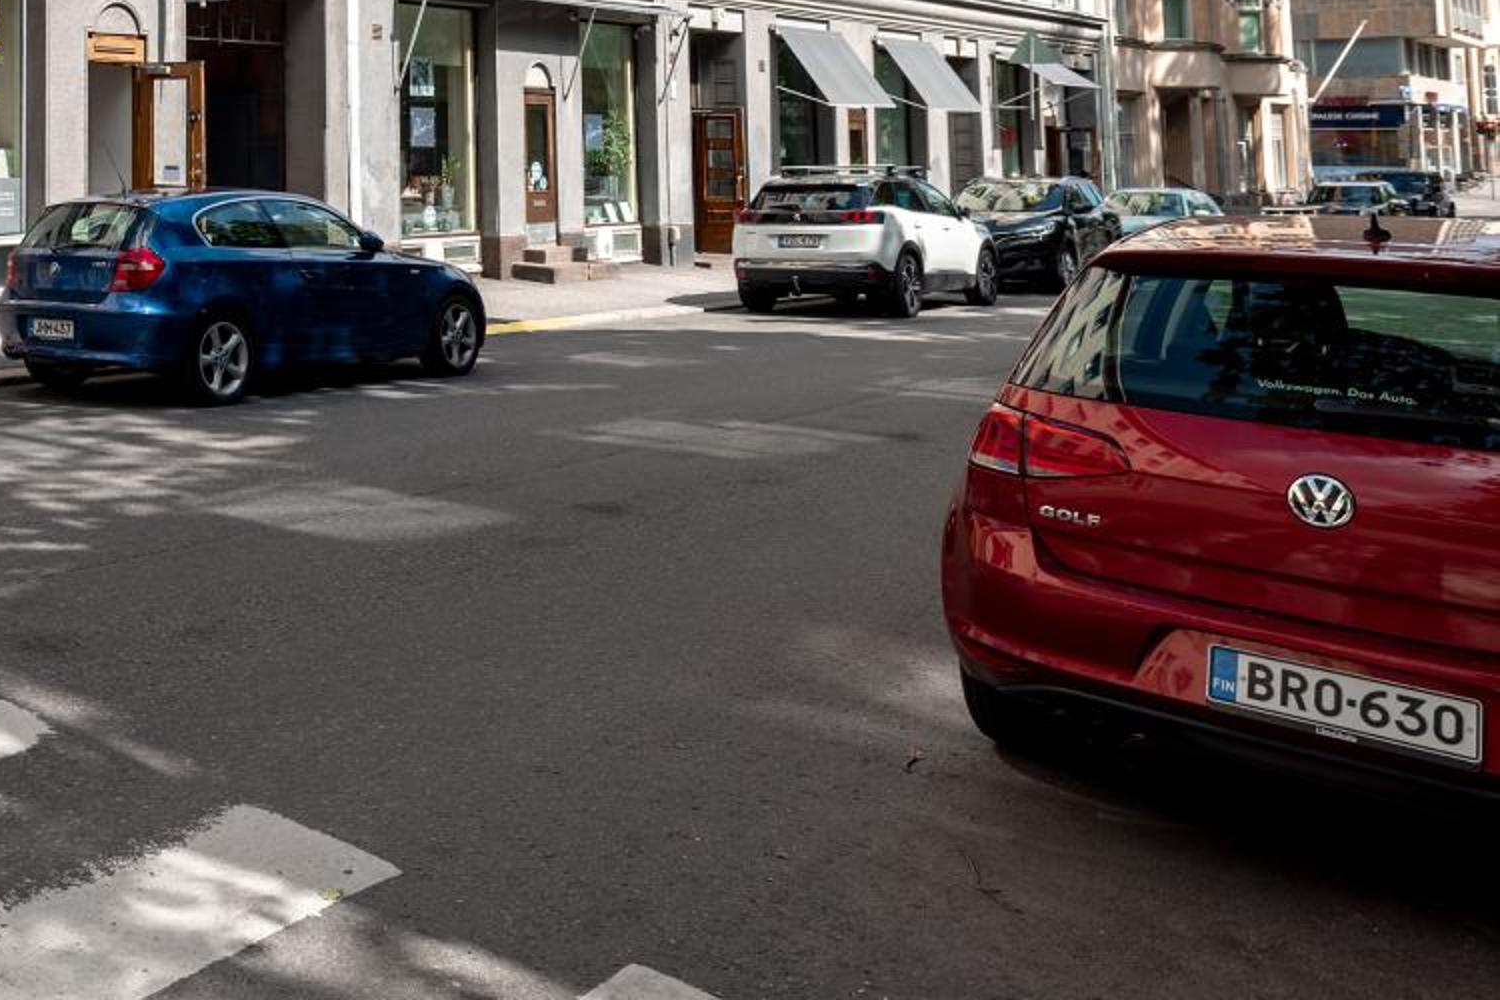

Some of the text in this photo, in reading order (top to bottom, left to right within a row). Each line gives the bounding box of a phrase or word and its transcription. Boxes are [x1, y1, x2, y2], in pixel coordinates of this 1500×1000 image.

[1347, 387, 1375, 400] Das
[1039, 505, 1101, 528] GOLF
[1212, 662, 1465, 746] FIN BRO-630
